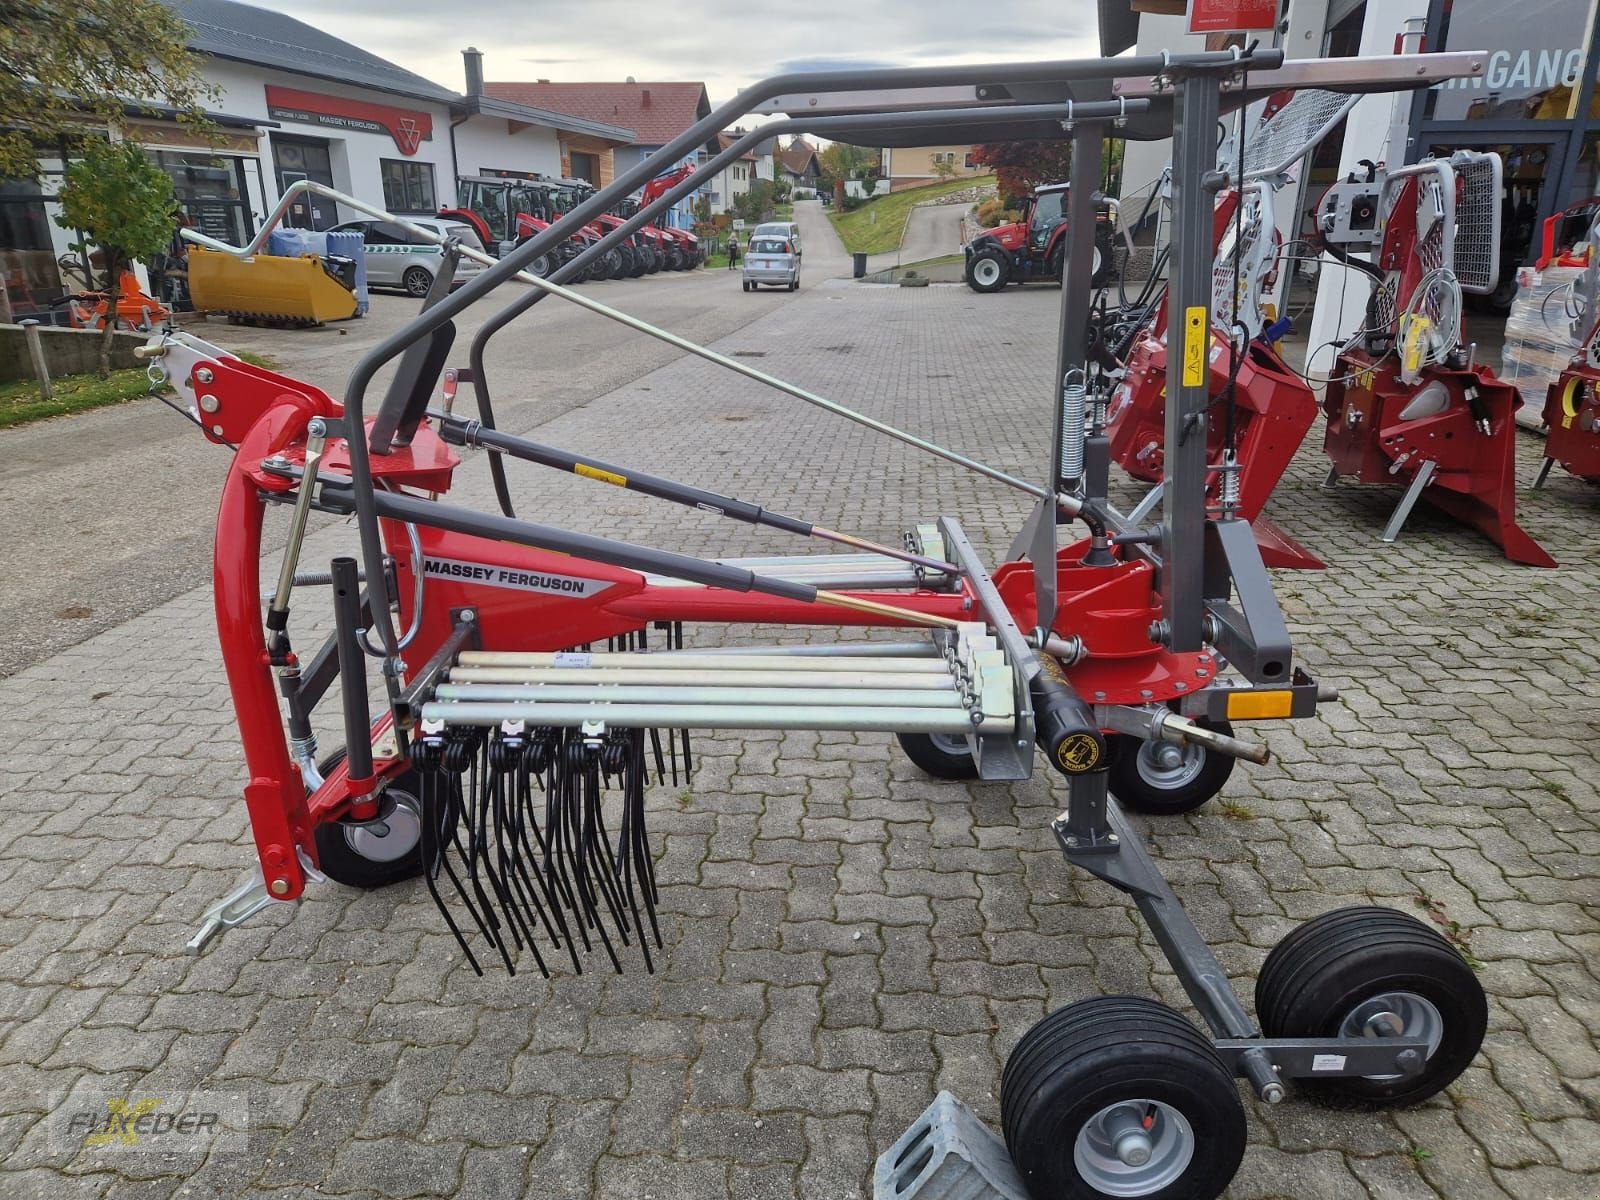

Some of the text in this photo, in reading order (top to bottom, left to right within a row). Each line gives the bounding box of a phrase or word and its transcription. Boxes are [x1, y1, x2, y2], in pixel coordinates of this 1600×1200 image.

[319, 115, 347, 126] MASSEY
[347, 119, 380, 131] FERGUSON
[425, 560, 585, 593] MASSEY FERGUSON
